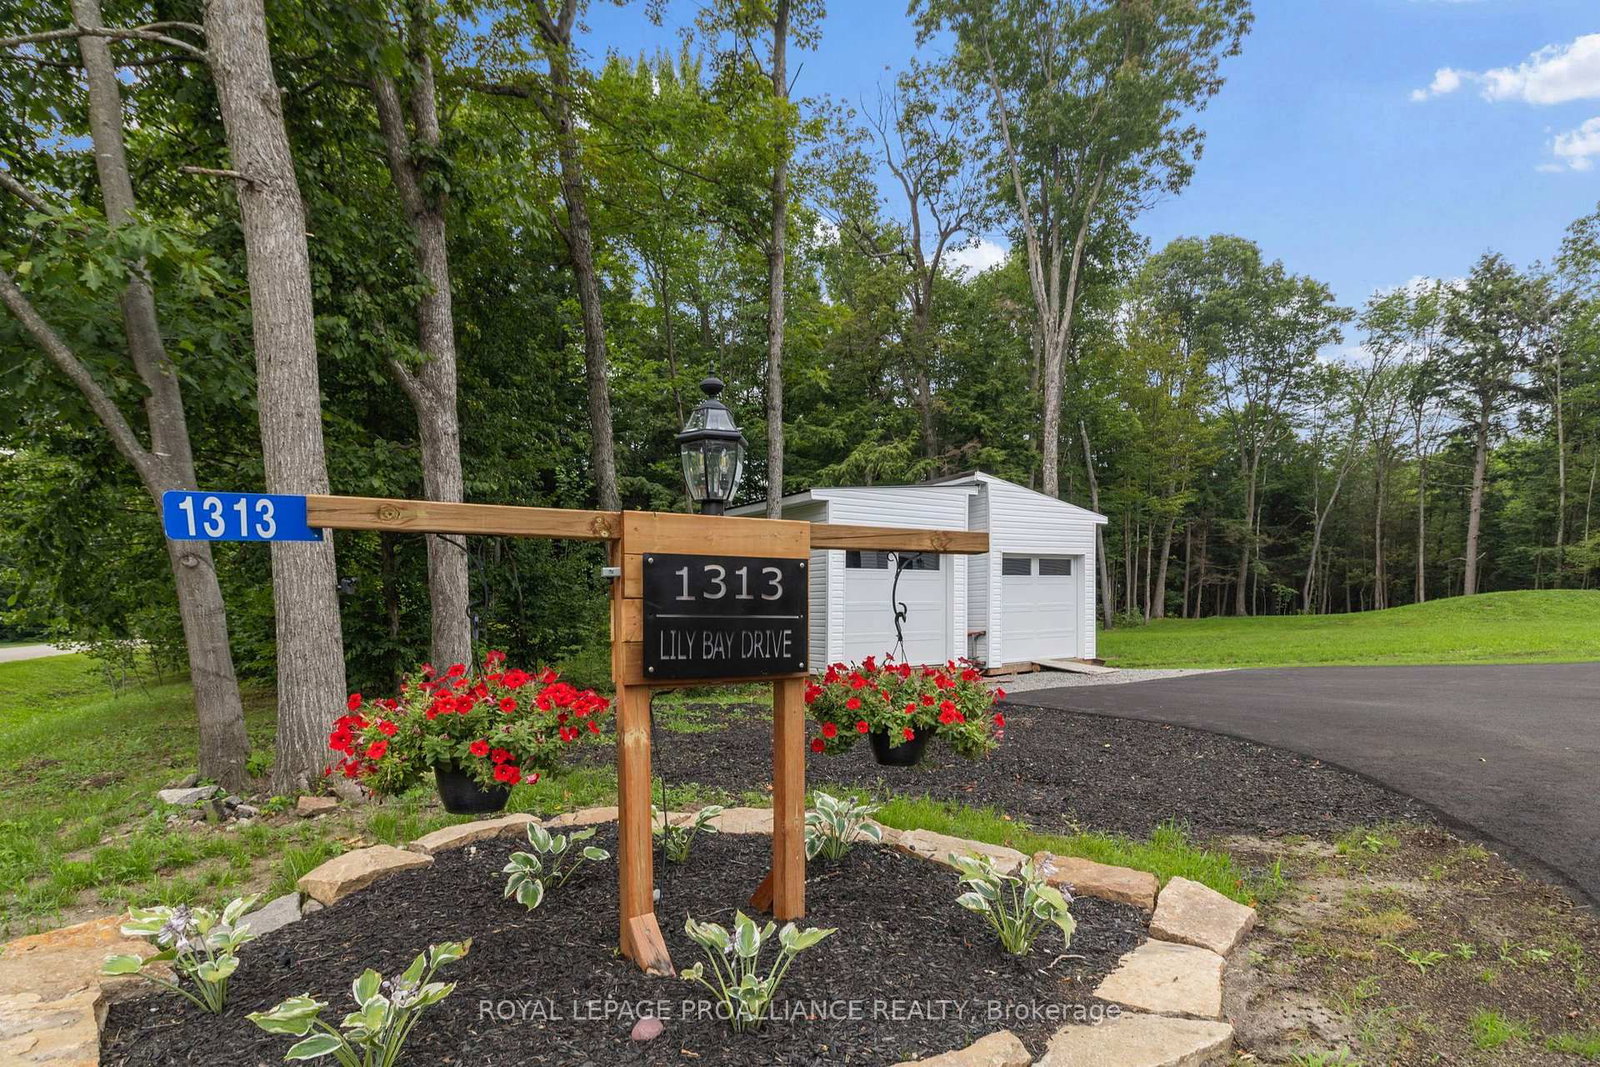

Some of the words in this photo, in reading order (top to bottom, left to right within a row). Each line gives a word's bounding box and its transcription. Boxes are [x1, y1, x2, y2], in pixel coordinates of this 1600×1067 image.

[178, 495, 277, 539] 1313
[675, 564, 784, 601] 1313
[660, 629, 697, 660] LILY
[702, 630, 735, 660] BAY
[741, 629, 792, 660] DRIVE
